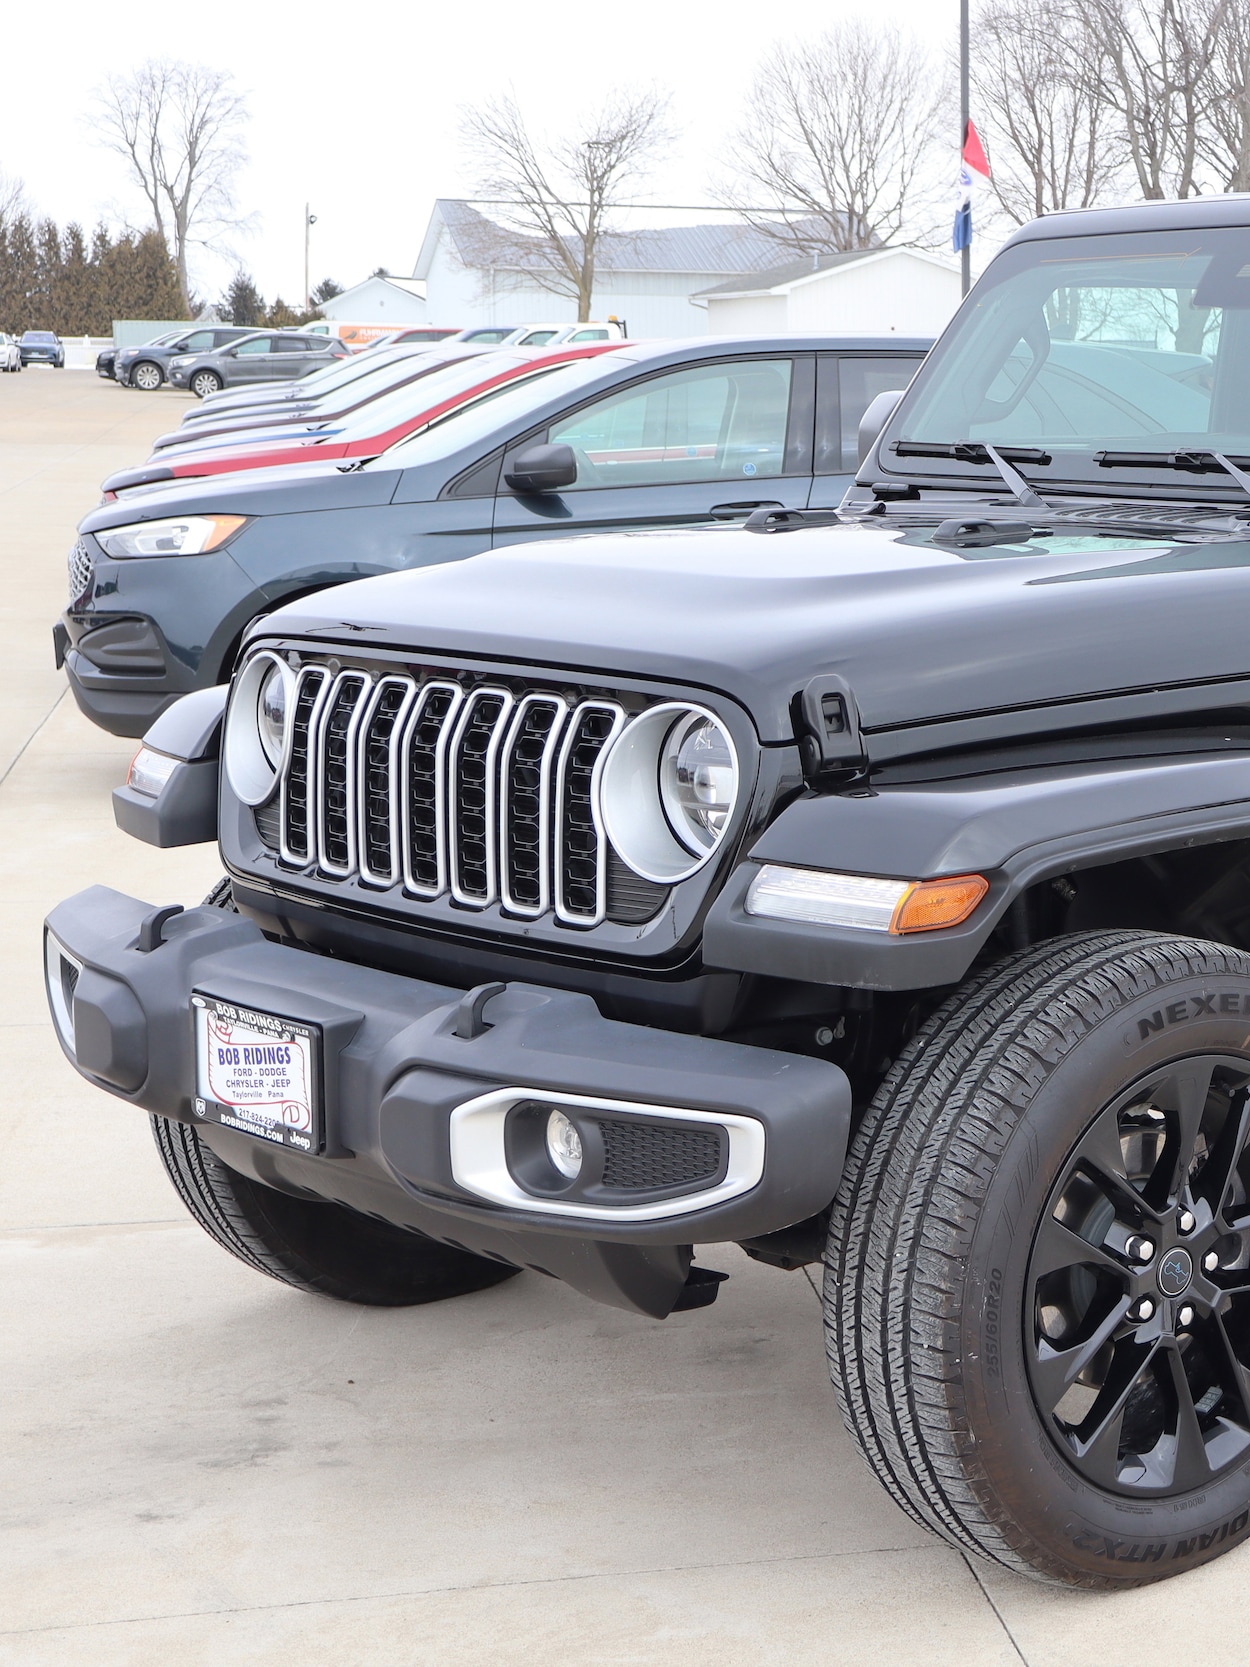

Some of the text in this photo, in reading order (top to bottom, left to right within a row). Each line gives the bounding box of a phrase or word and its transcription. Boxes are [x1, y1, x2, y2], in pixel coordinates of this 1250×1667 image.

[216, 1003, 309, 1036] BOB RIDINGS CHRYSLER
[218, 1046, 291, 1065] BOB RIDINGS
[233, 1068, 253, 1077] FORD
[259, 1067, 287, 1077] DODGE
[226, 1079, 264, 1088] CHRYSLER
[271, 1079, 291, 1088] JEEP
[232, 1090, 284, 1099] Taylorville Pana
[220, 1113, 284, 1143] BOBRIDINGS.COM
[290, 1131, 311, 1150] Jeep
[985, 1267, 1003, 1377] 255/60R20
